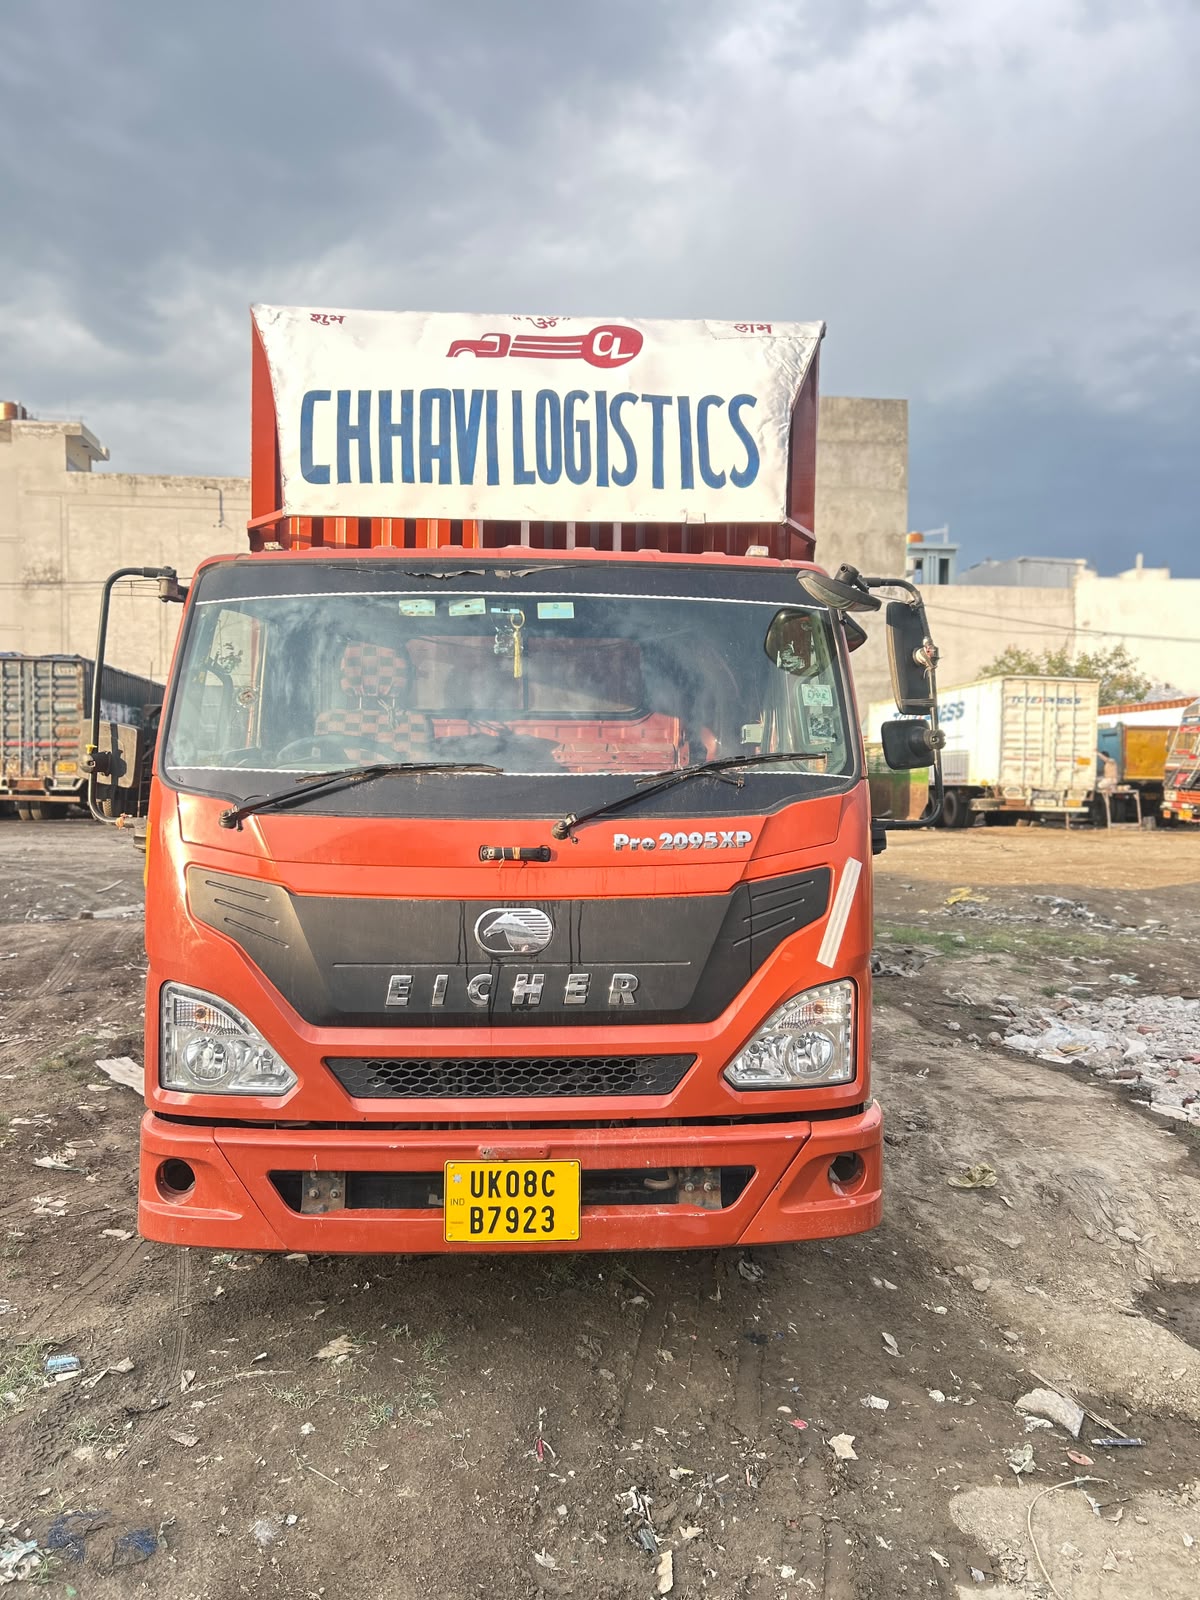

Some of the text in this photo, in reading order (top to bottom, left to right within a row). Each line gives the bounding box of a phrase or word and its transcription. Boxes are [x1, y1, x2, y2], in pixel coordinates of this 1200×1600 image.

[310, 313, 347, 326] शुभ
[733, 323, 773, 334] लाभ
[300, 388, 760, 490] CHHAVI LOGISTICS
[613, 831, 752, 851] Pro 2095XP
[385, 973, 639, 1007] EICHER
[470, 1170, 555, 1198] UK08C
[450, 1198, 465, 1206] IND
[470, 1206, 555, 1234] B7923
